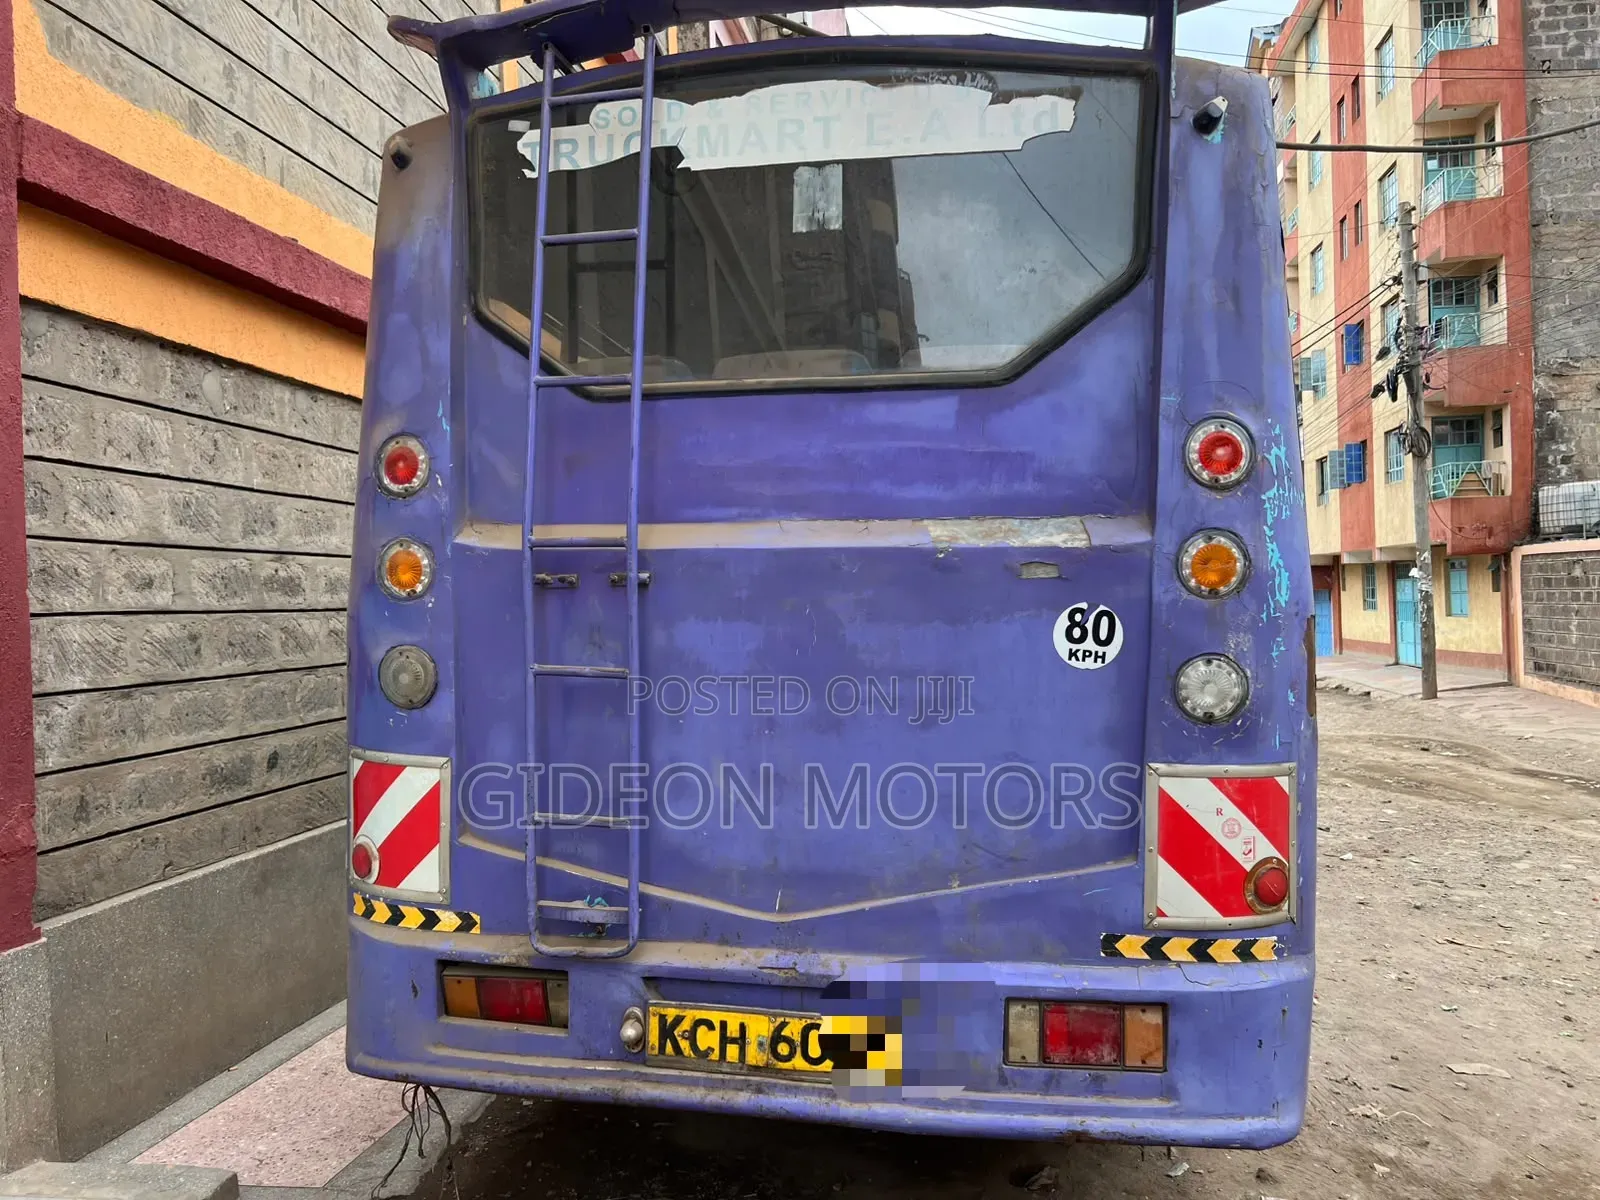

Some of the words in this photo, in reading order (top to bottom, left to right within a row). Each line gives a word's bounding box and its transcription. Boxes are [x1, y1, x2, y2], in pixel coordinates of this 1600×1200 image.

[1064, 607, 1116, 648] 80
[1067, 648, 1107, 664] KPH
[658, 1013, 747, 1063] KCH
